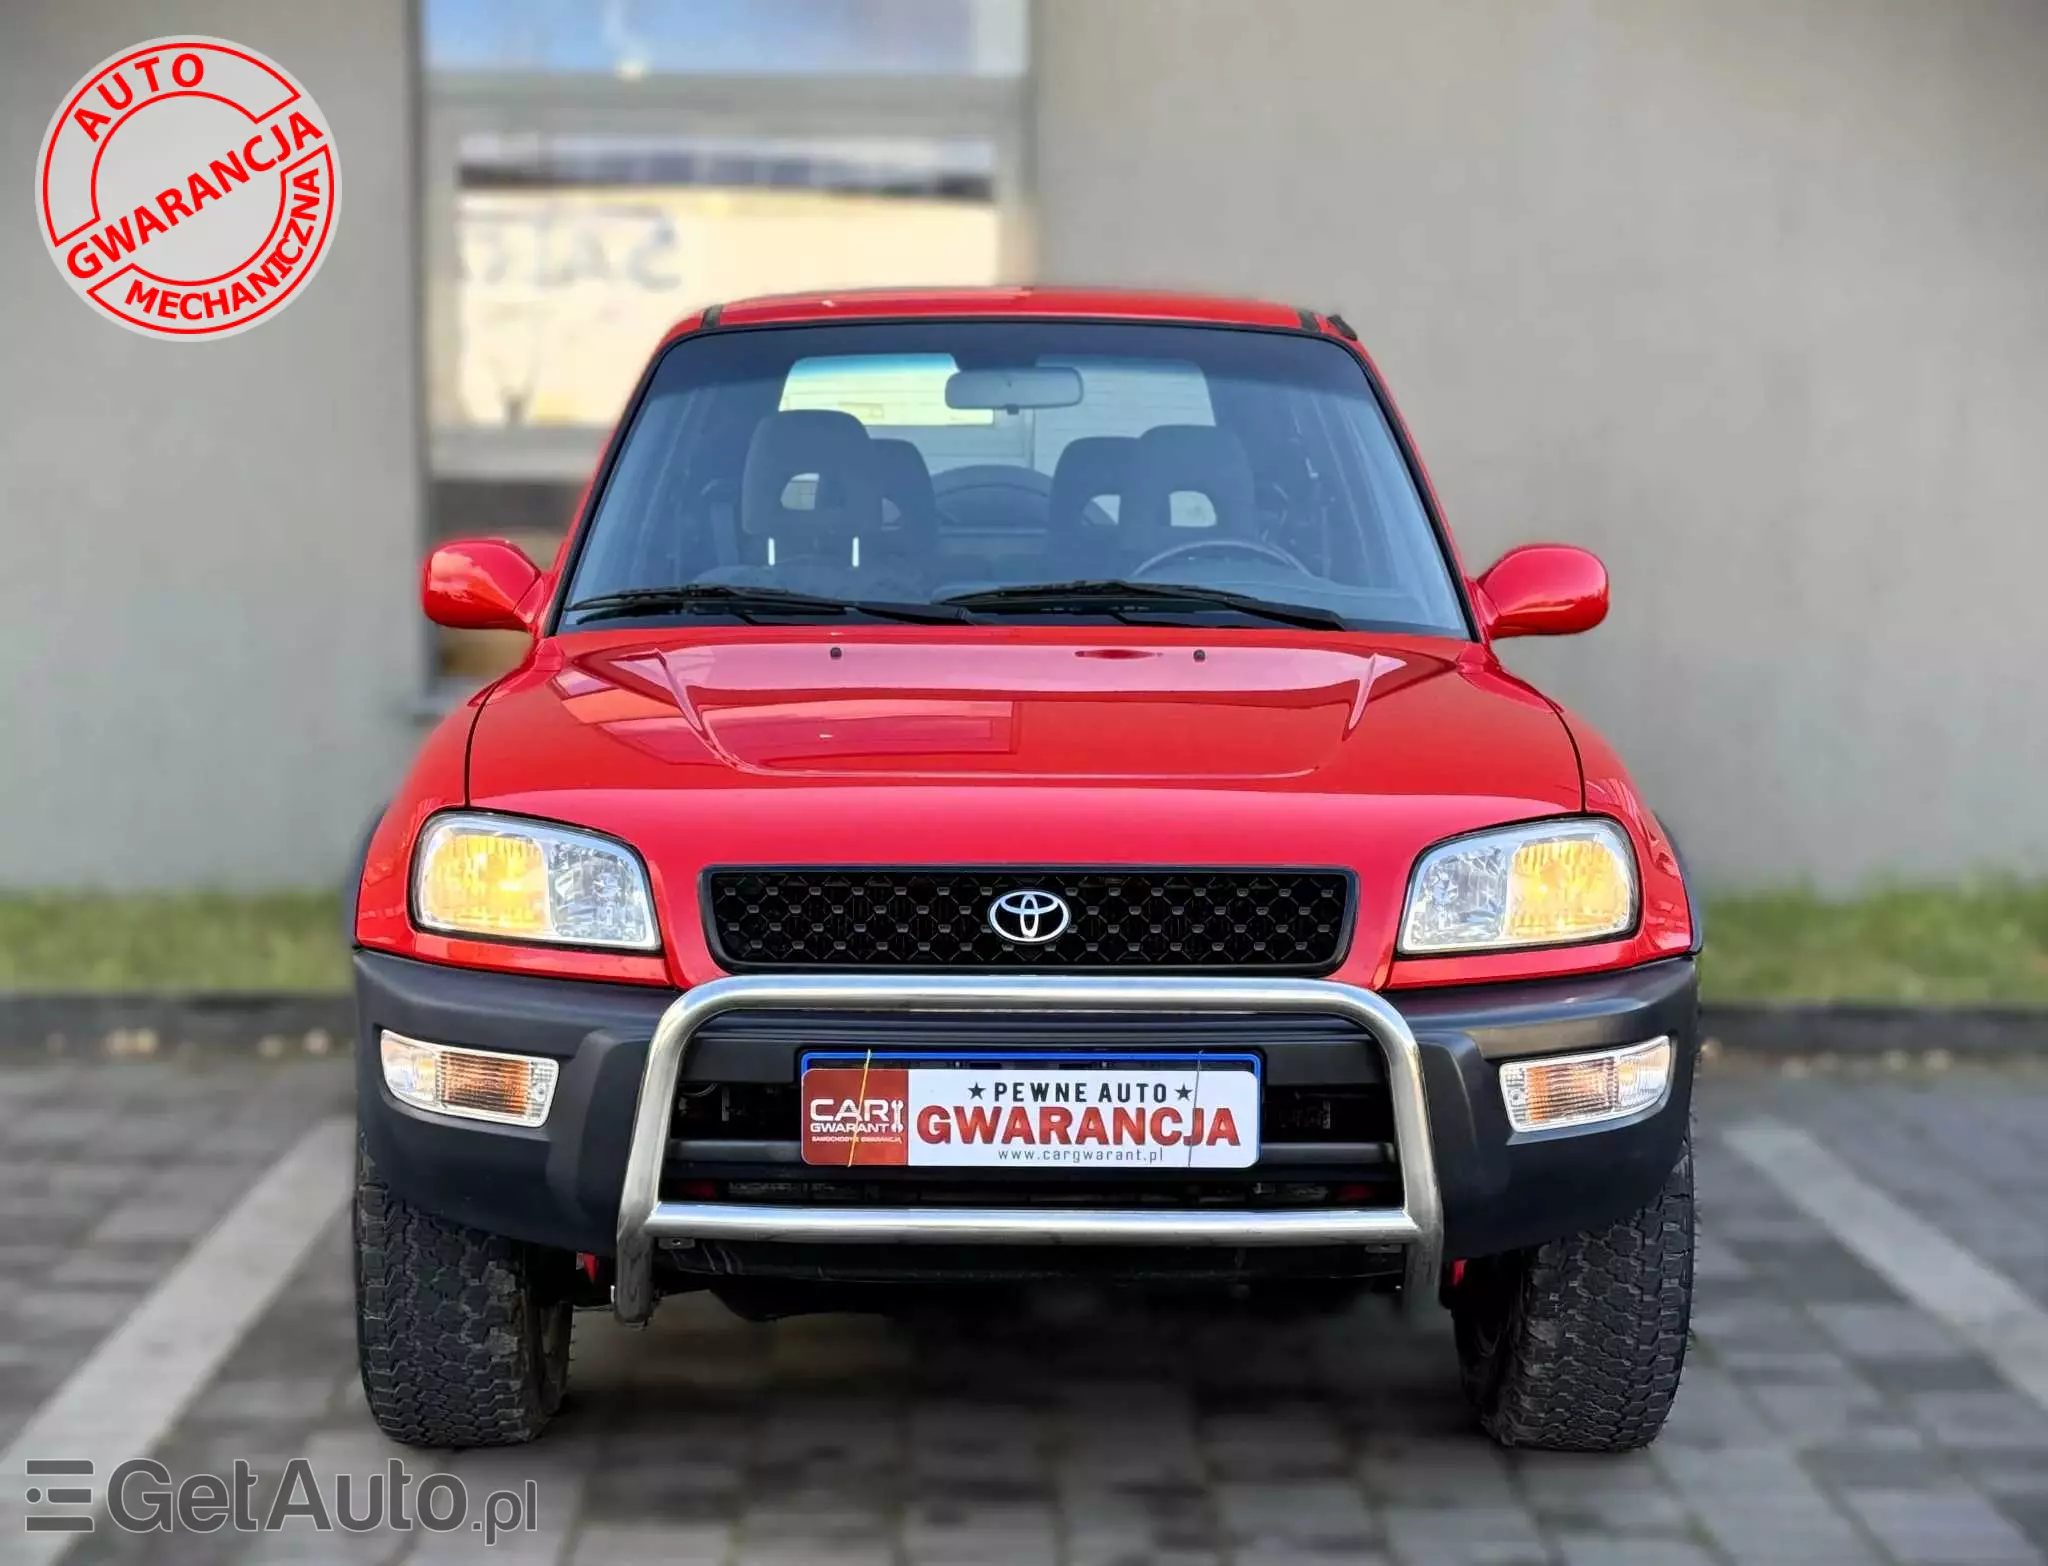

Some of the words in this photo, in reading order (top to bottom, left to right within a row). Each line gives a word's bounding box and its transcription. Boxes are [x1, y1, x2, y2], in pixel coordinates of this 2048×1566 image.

[994, 1082, 1087, 1103] PEWNE
[1098, 1083, 1168, 1103] AUTO
[810, 1098, 890, 1121] CAR
[810, 1122, 890, 1133] GWARANT
[916, 1105, 1241, 1147] GWARANCJA
[998, 1147, 1164, 1164] www.cargwarant.pl
